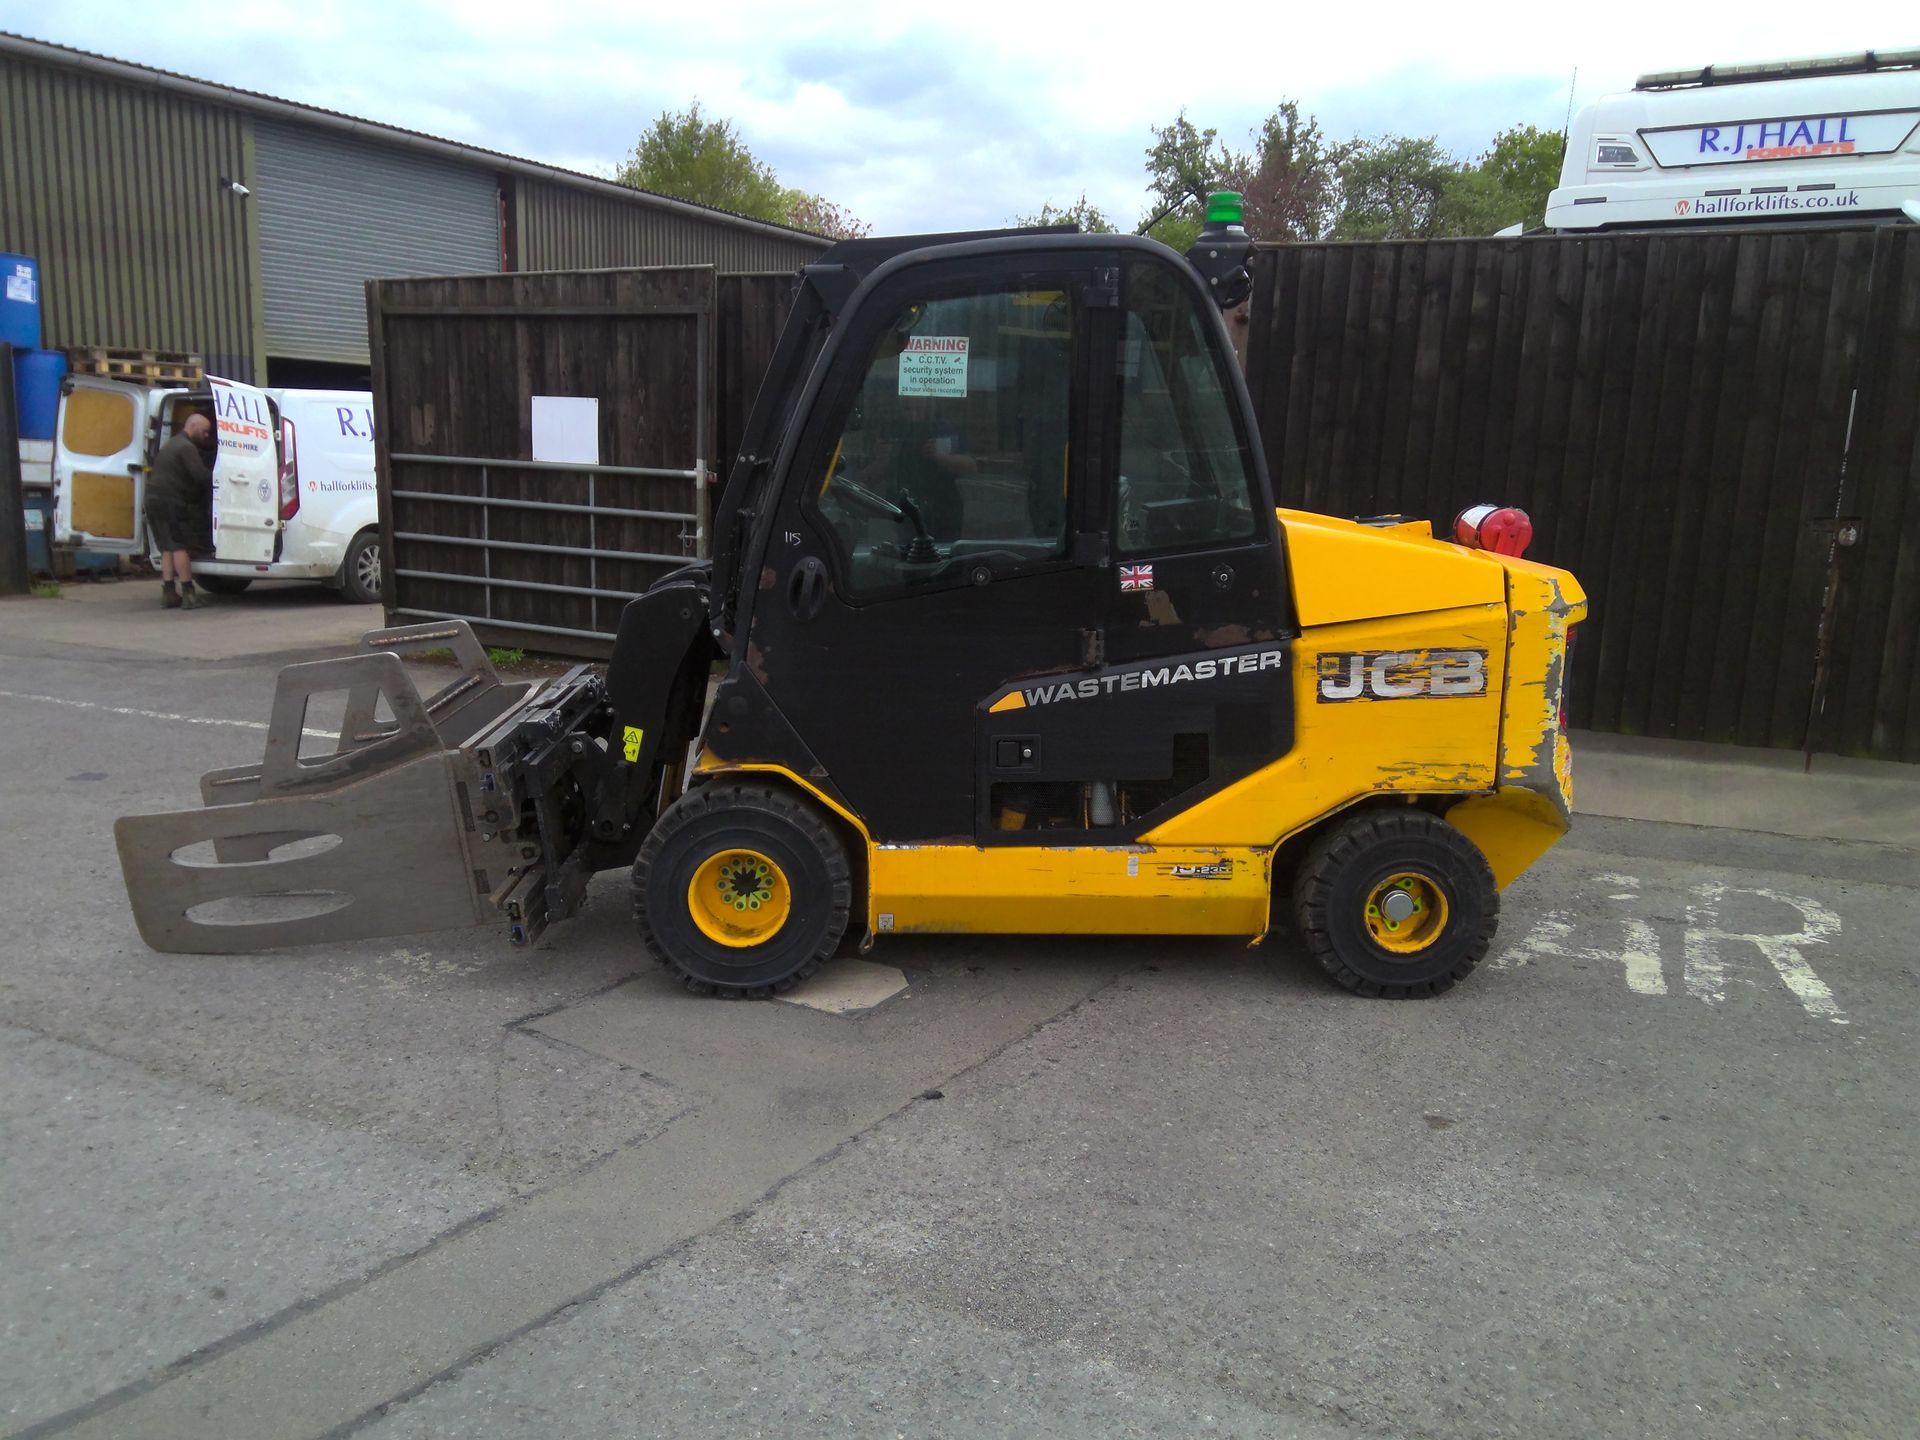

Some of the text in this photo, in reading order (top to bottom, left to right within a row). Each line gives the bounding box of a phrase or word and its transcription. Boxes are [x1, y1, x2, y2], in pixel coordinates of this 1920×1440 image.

[1746, 141, 1855, 160] FORKLIFTS
[1694, 190, 1859, 214] hallforklifts.co.uk
[903, 366, 963, 376] security system
[918, 377, 956, 385] operation
[242, 442, 259, 452] HIRE
[1025, 650, 1283, 706] WASTEMASTER
[1321, 650, 1486, 699] JCB
